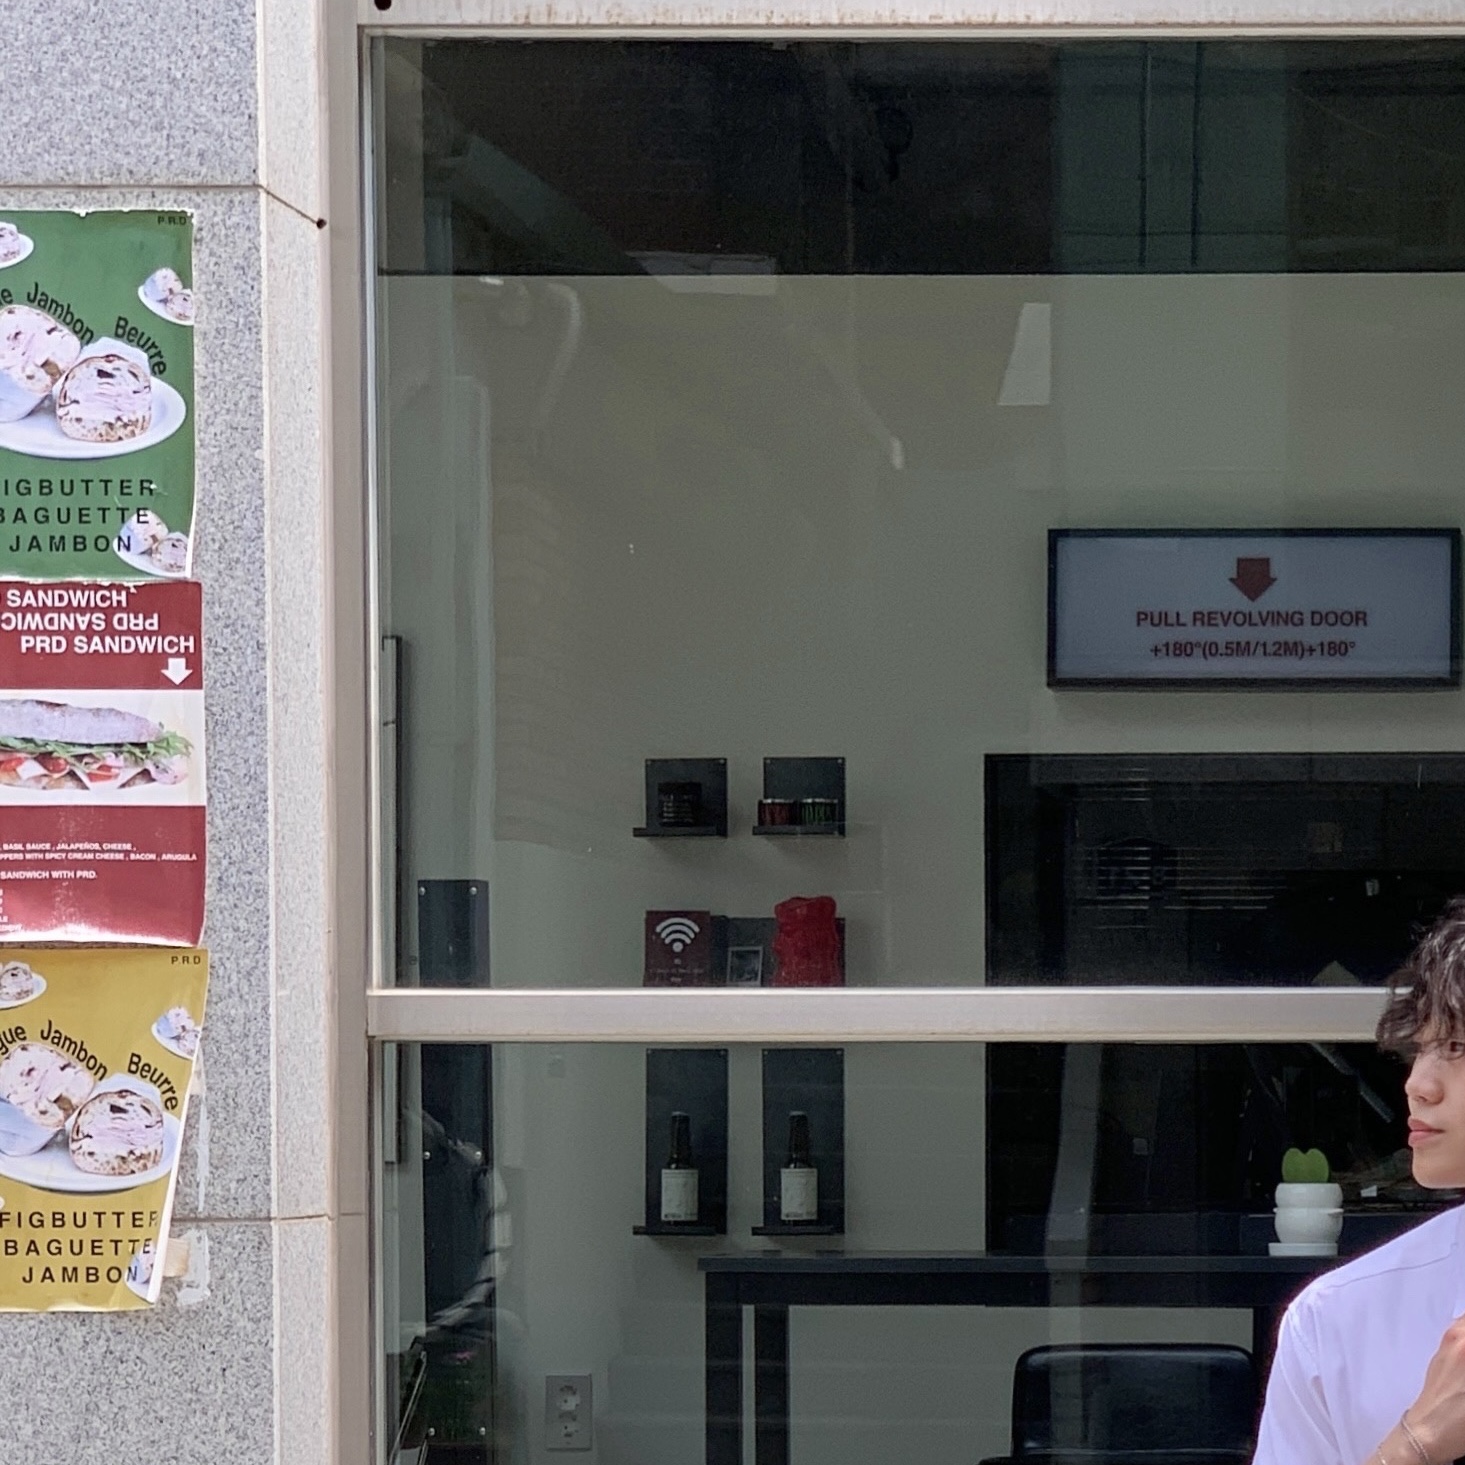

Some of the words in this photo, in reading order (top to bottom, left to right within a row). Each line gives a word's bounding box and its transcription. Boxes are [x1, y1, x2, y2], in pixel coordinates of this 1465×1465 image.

[26, 281, 95, 346] Jambon
[114, 315, 167, 376] Beurre
[9, 535, 132, 553] JAMBON
[7, 589, 128, 608] SANDWICH
[1136, 610, 1188, 628] PULL
[1192, 610, 1304, 628] REVOLVING
[1310, 610, 1368, 628] DOOR
[20, 636, 68, 653] PRD
[74, 636, 195, 654] SANDWICH
[25, 852, 44, 860] WITH
[44, 852, 67, 860] SPICY
[67, 852, 95, 860] CREAM
[161, 853, 197, 861] ARUGULA
[0, 870, 50, 880] SANDWICH
[50, 870, 75, 880] WITH
[40, 1018, 108, 1082] Jambon
[127, 1052, 179, 1111] Beurre
[0, 1210, 159, 1229] FIGBUTTER
[4, 1237, 153, 1256] BAGUETTE
[22, 1265, 138, 1284] JAMBON
